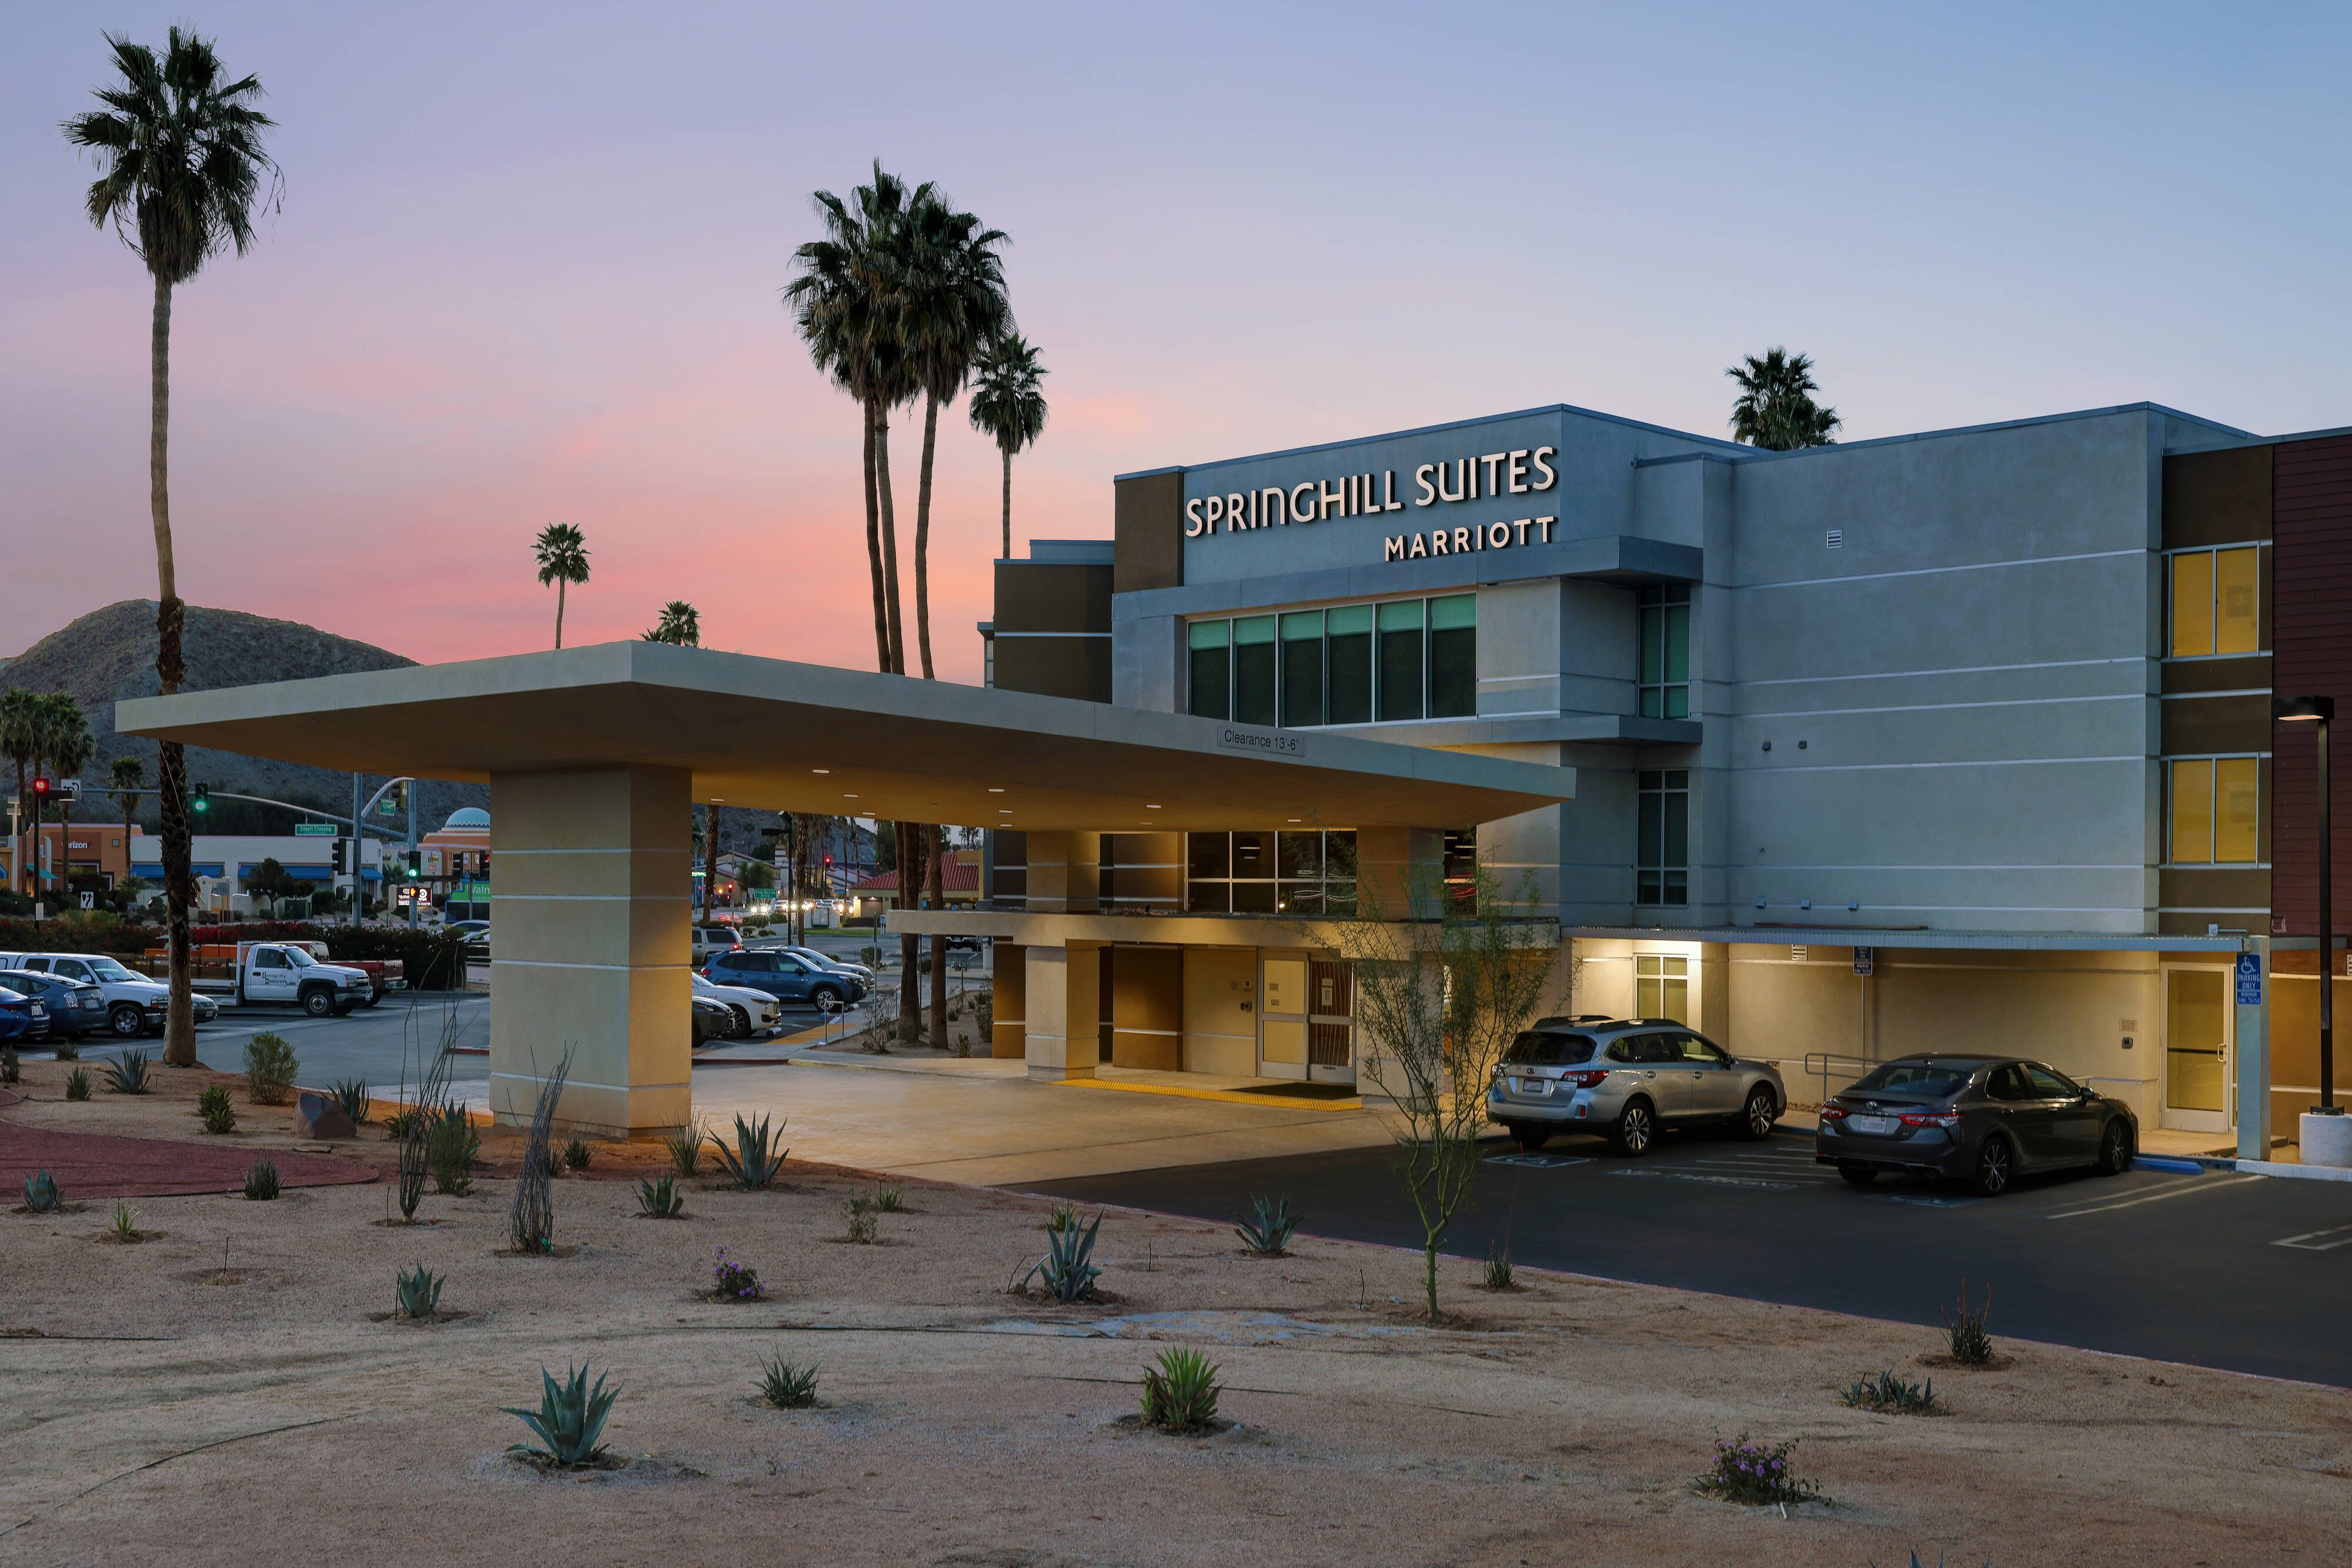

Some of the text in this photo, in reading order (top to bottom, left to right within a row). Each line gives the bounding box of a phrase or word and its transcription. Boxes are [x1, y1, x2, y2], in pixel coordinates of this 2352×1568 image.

[1185, 446, 1556, 538] SPRINGHILL SUITES
[1385, 516, 1555, 561] MARRIOTT
[1224, 729, 1299, 750] Clearance 13'-6"
[2237, 973, 2260, 982] PARKING
[2242, 982, 2256, 990] ONLY
